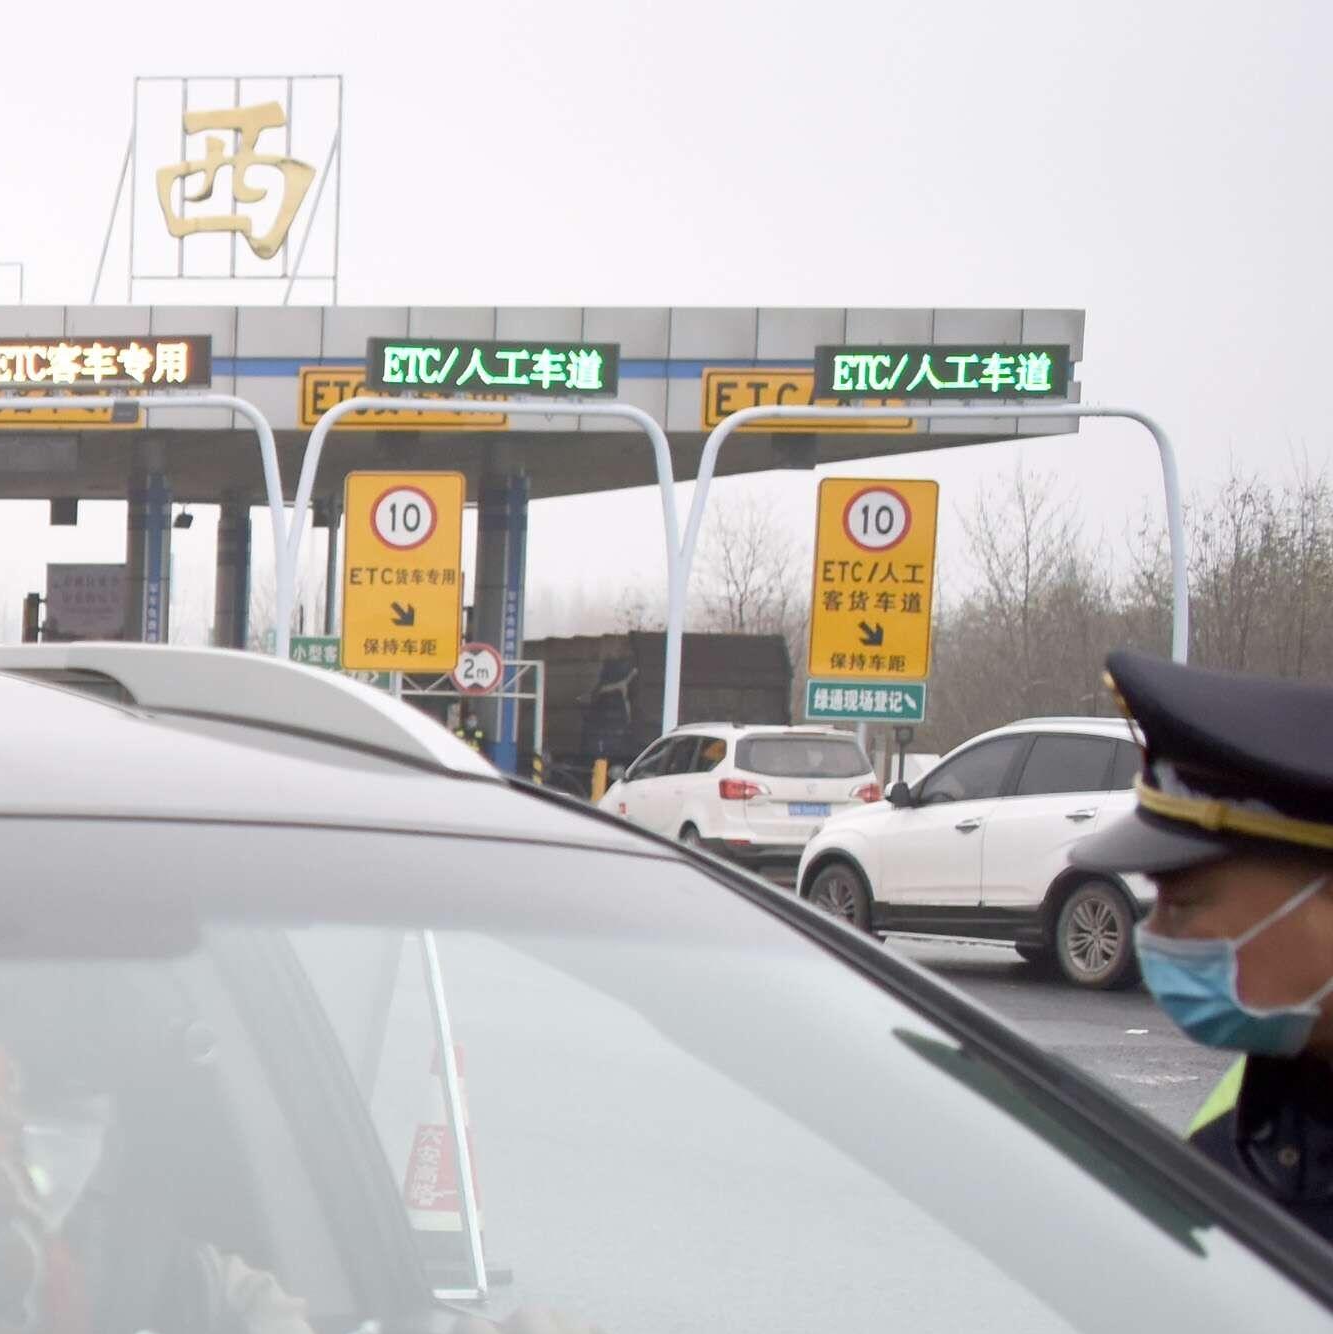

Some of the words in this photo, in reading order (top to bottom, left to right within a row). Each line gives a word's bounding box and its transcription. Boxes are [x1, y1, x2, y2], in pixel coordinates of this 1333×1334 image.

[382, 346, 603, 390] ETC/人工车道
[832, 352, 1052, 392] ETC/人工车道
[390, 503, 420, 533] 10
[861, 504, 894, 535] 10
[349, 567, 455, 586] ETC货车专用
[822, 561, 924, 584] ETC/人工
[823, 590, 922, 613] 客货车道
[363, 638, 438, 656] 保持车距
[830, 653, 906, 672] 保持车距
